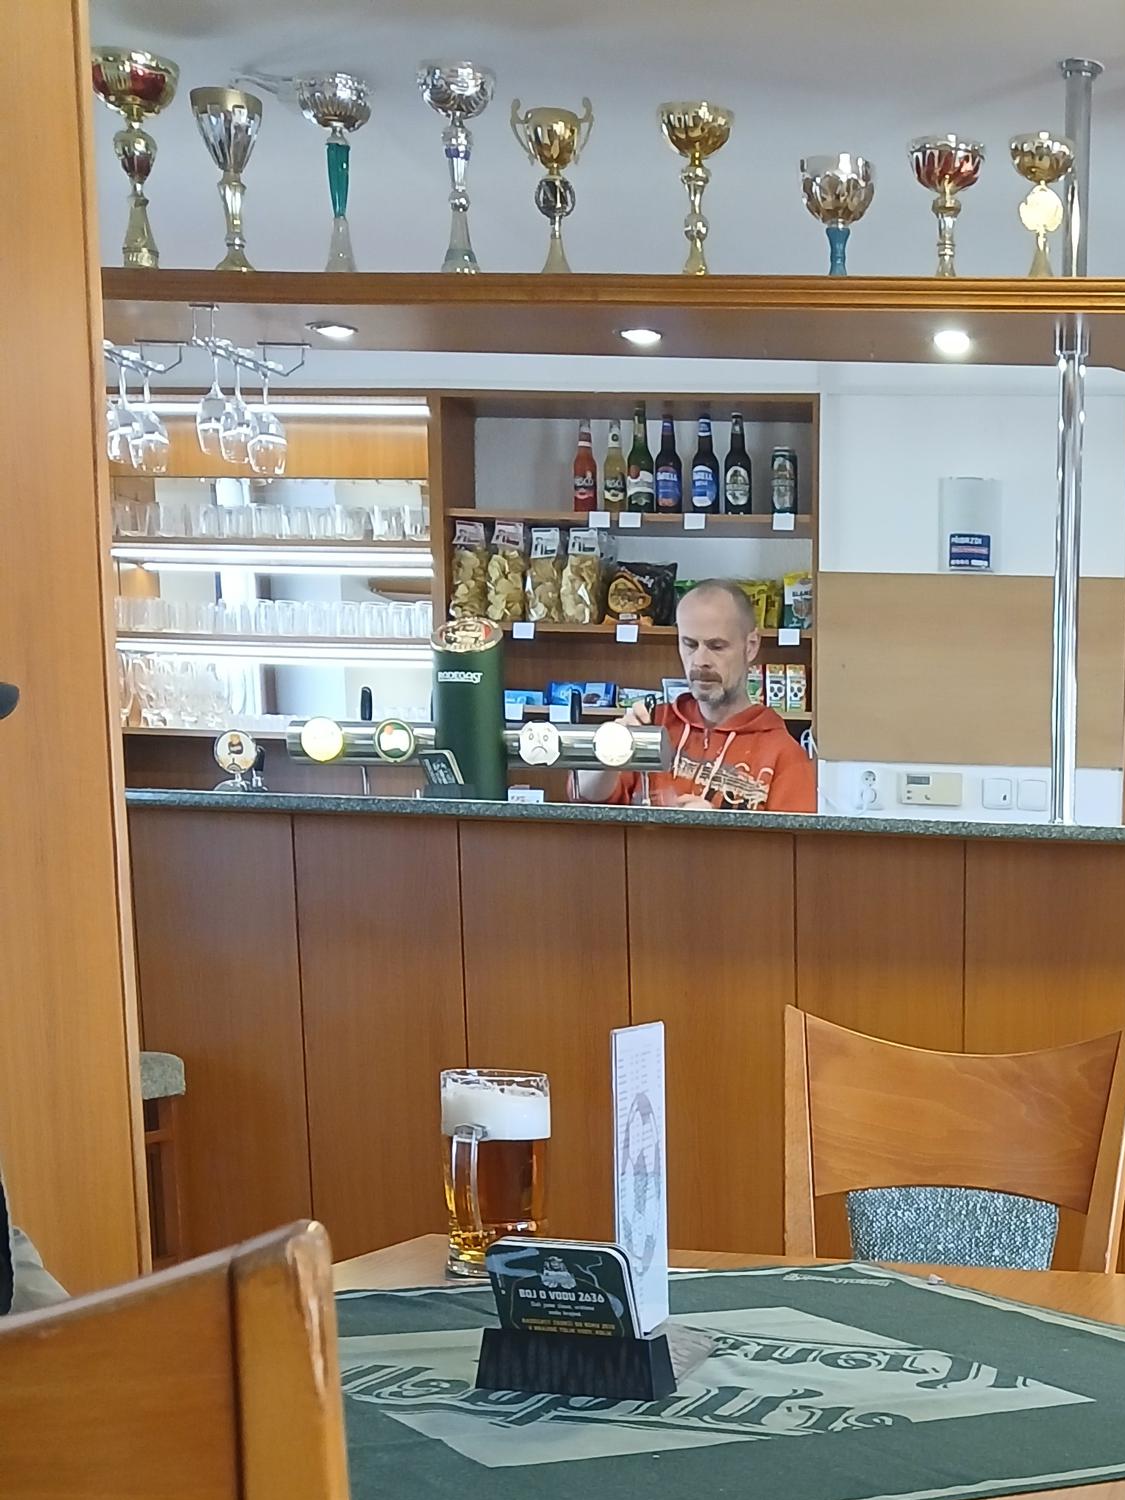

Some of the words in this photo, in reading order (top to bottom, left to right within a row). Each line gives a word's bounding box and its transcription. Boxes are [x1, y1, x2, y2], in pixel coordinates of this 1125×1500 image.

[518, 1288, 537, 1299] BOJ
[539, 1289, 547, 1299] O
[549, 1290, 576, 1301] VODU
